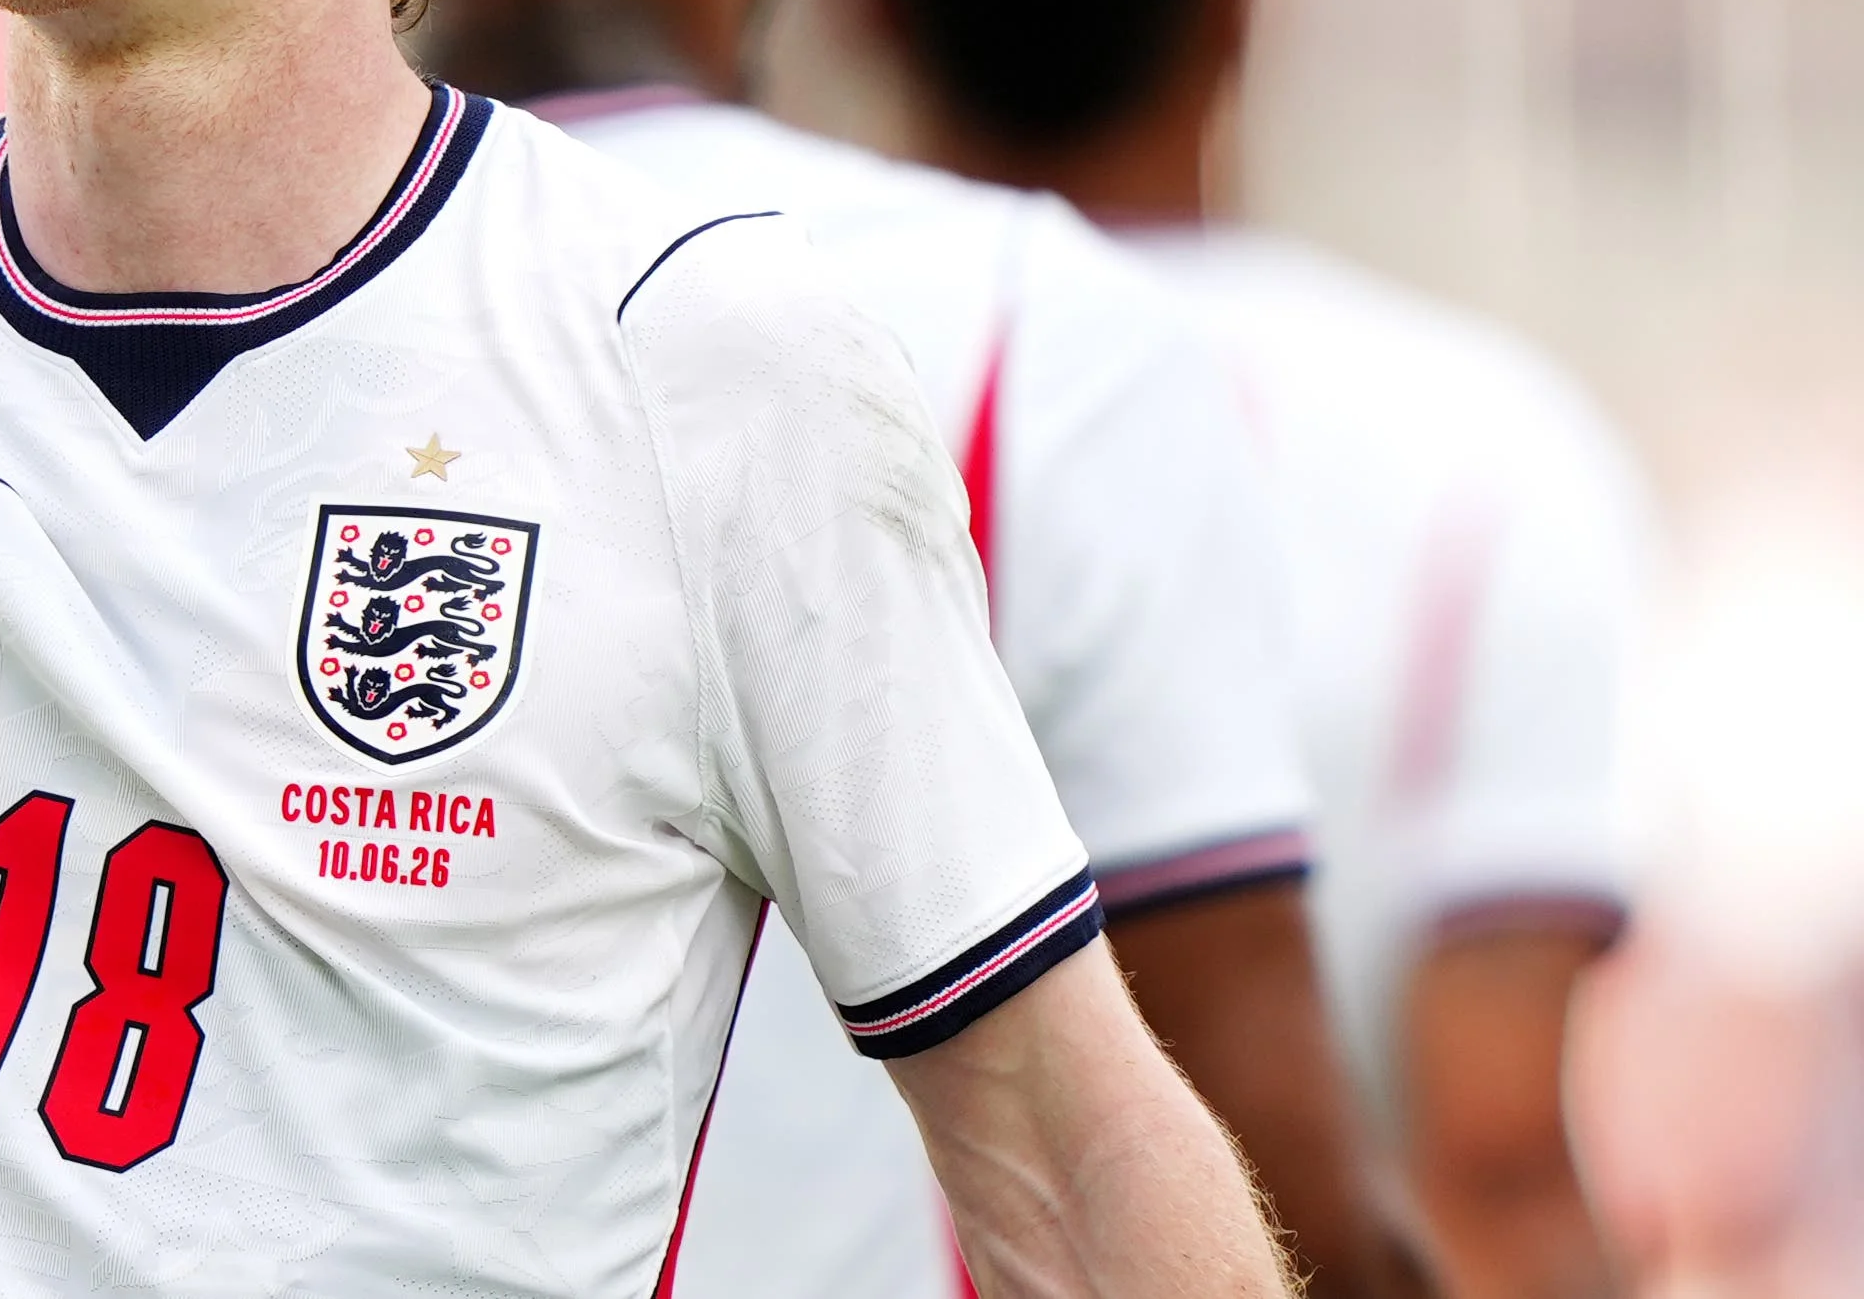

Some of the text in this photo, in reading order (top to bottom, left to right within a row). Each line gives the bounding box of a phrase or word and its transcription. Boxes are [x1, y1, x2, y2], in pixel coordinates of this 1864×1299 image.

[281, 782, 496, 839] COSTA RICA
[318, 839, 451, 889] 10.06.26
